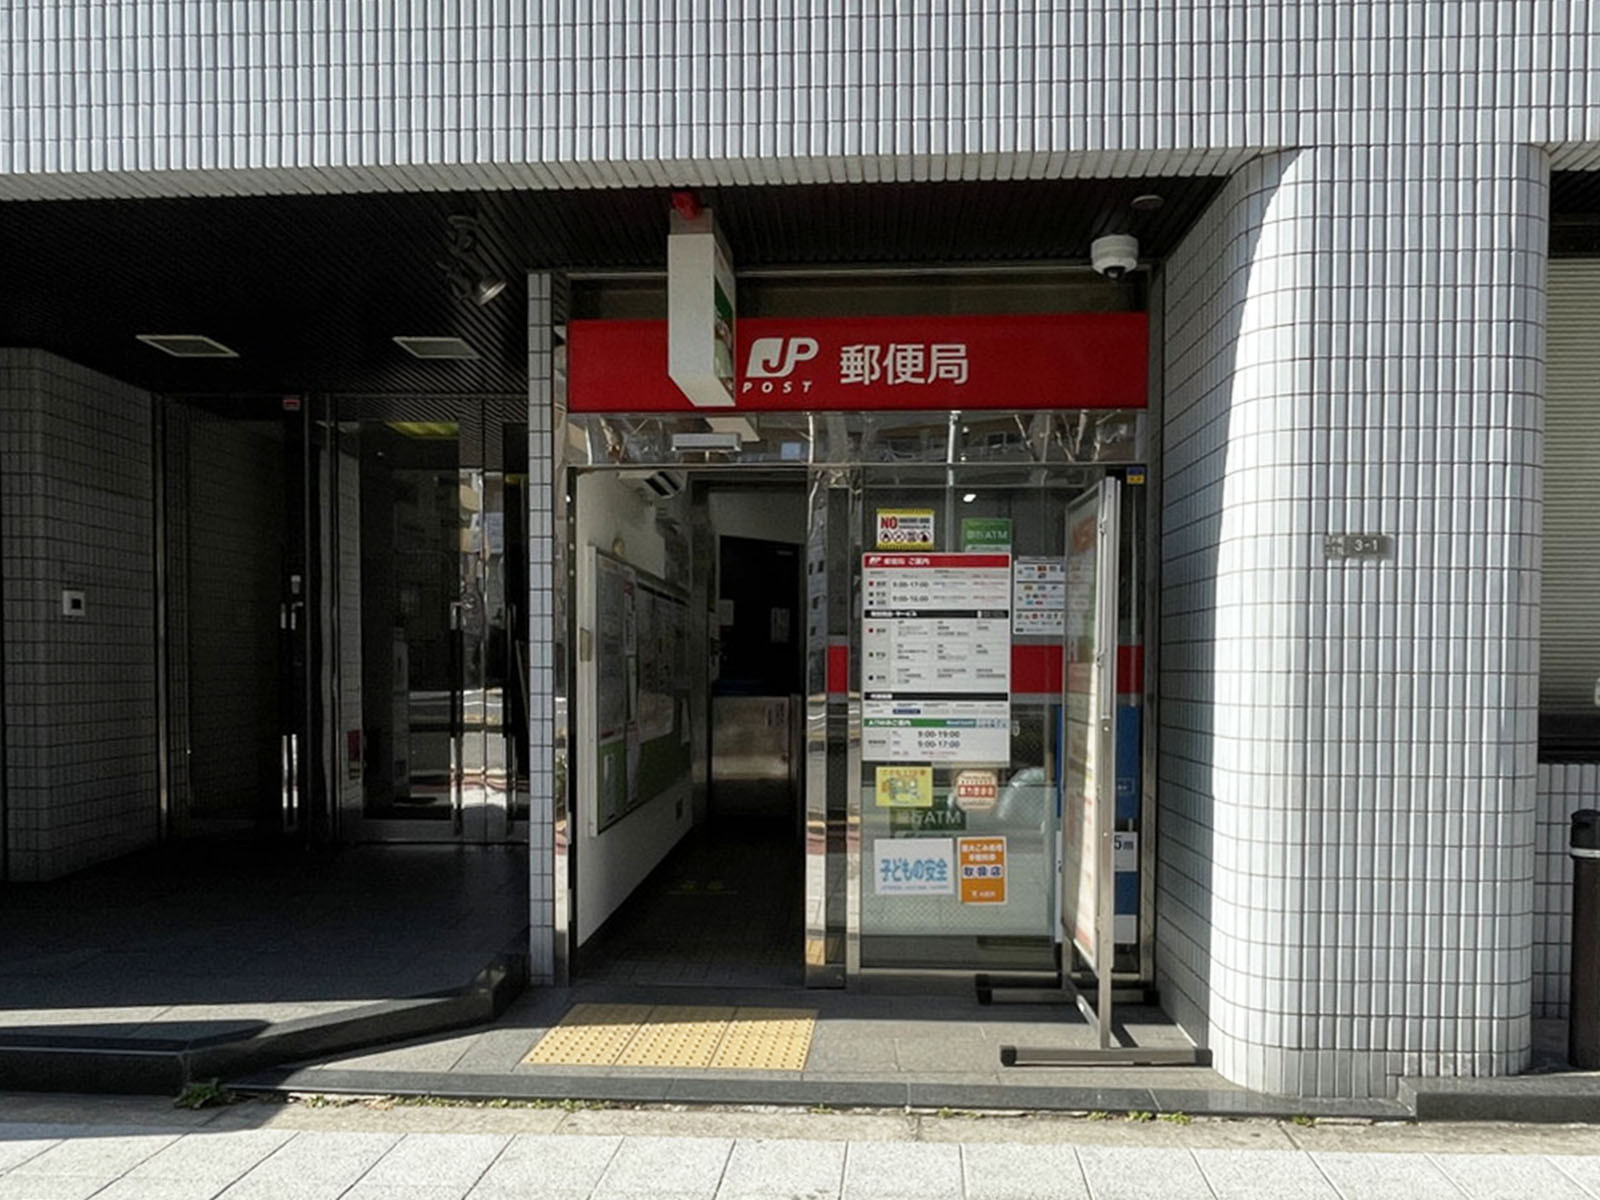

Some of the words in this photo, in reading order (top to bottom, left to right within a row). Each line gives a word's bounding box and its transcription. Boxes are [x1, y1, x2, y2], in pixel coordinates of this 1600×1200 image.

[840, 344, 968, 384] 郵便局
[741, 380, 813, 394] POST
[880, 516, 898, 529] NO
[879, 857, 948, 882] 子どもの安全
